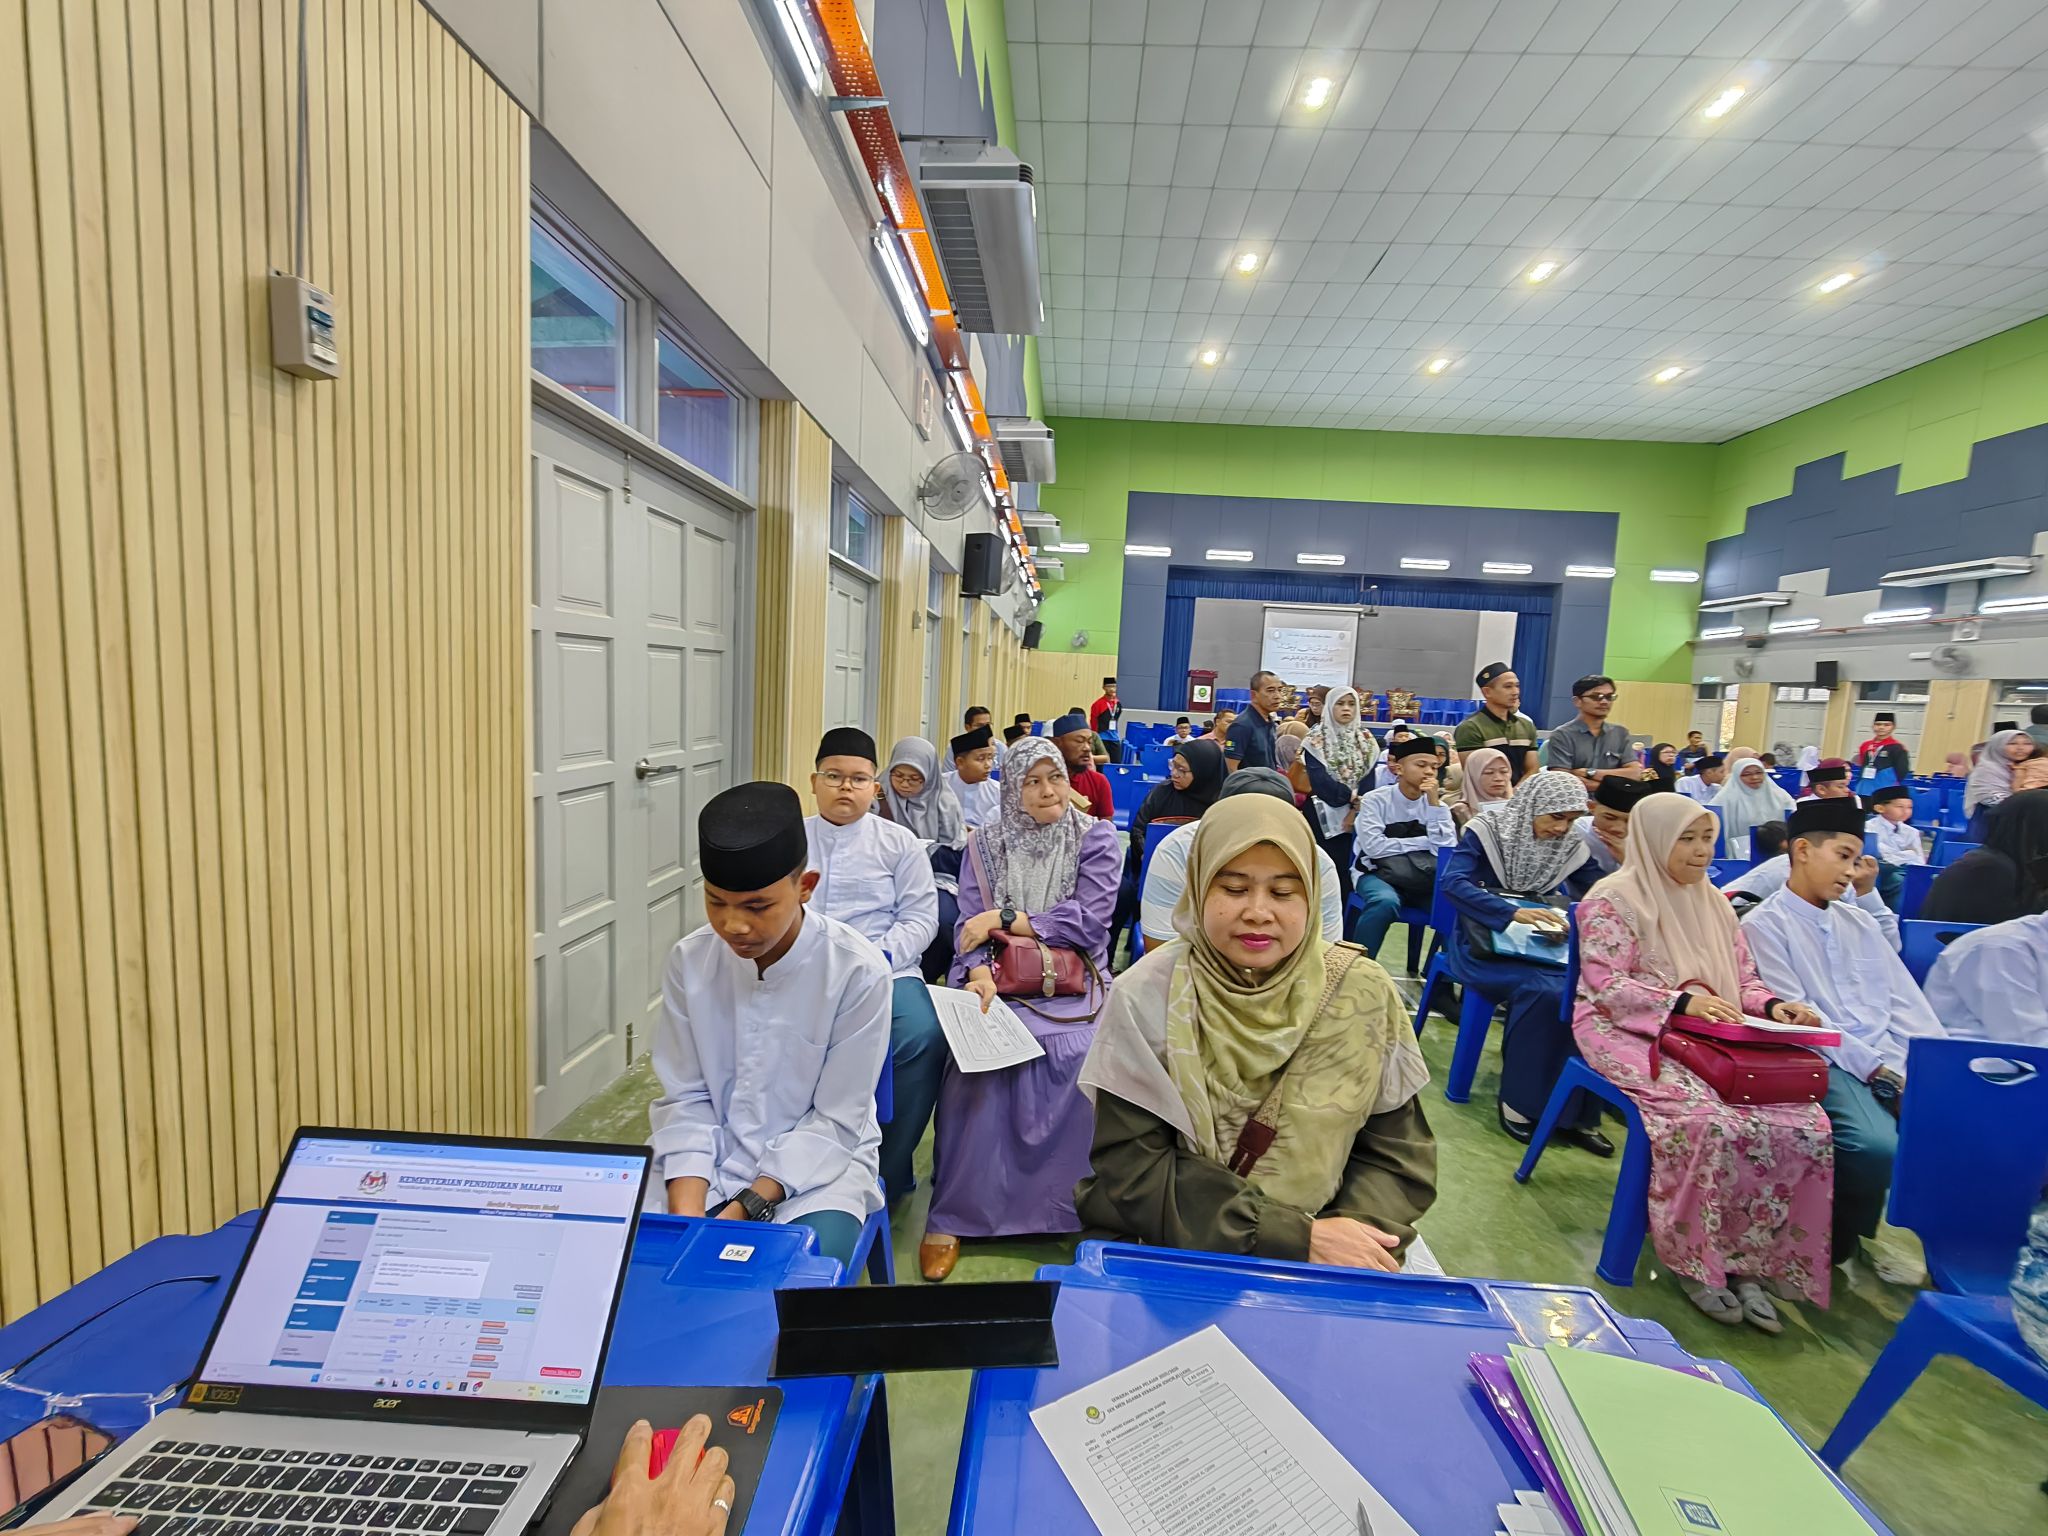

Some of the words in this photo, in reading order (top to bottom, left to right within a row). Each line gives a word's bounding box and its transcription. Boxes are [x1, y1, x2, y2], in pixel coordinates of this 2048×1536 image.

[399, 1175, 462, 1187] KEMENTERIAN
[464, 1180, 517, 1190] PENDIDIKAN
[519, 1182, 563, 1192] MALAYSIA
[373, 1398, 402, 1409] acer
